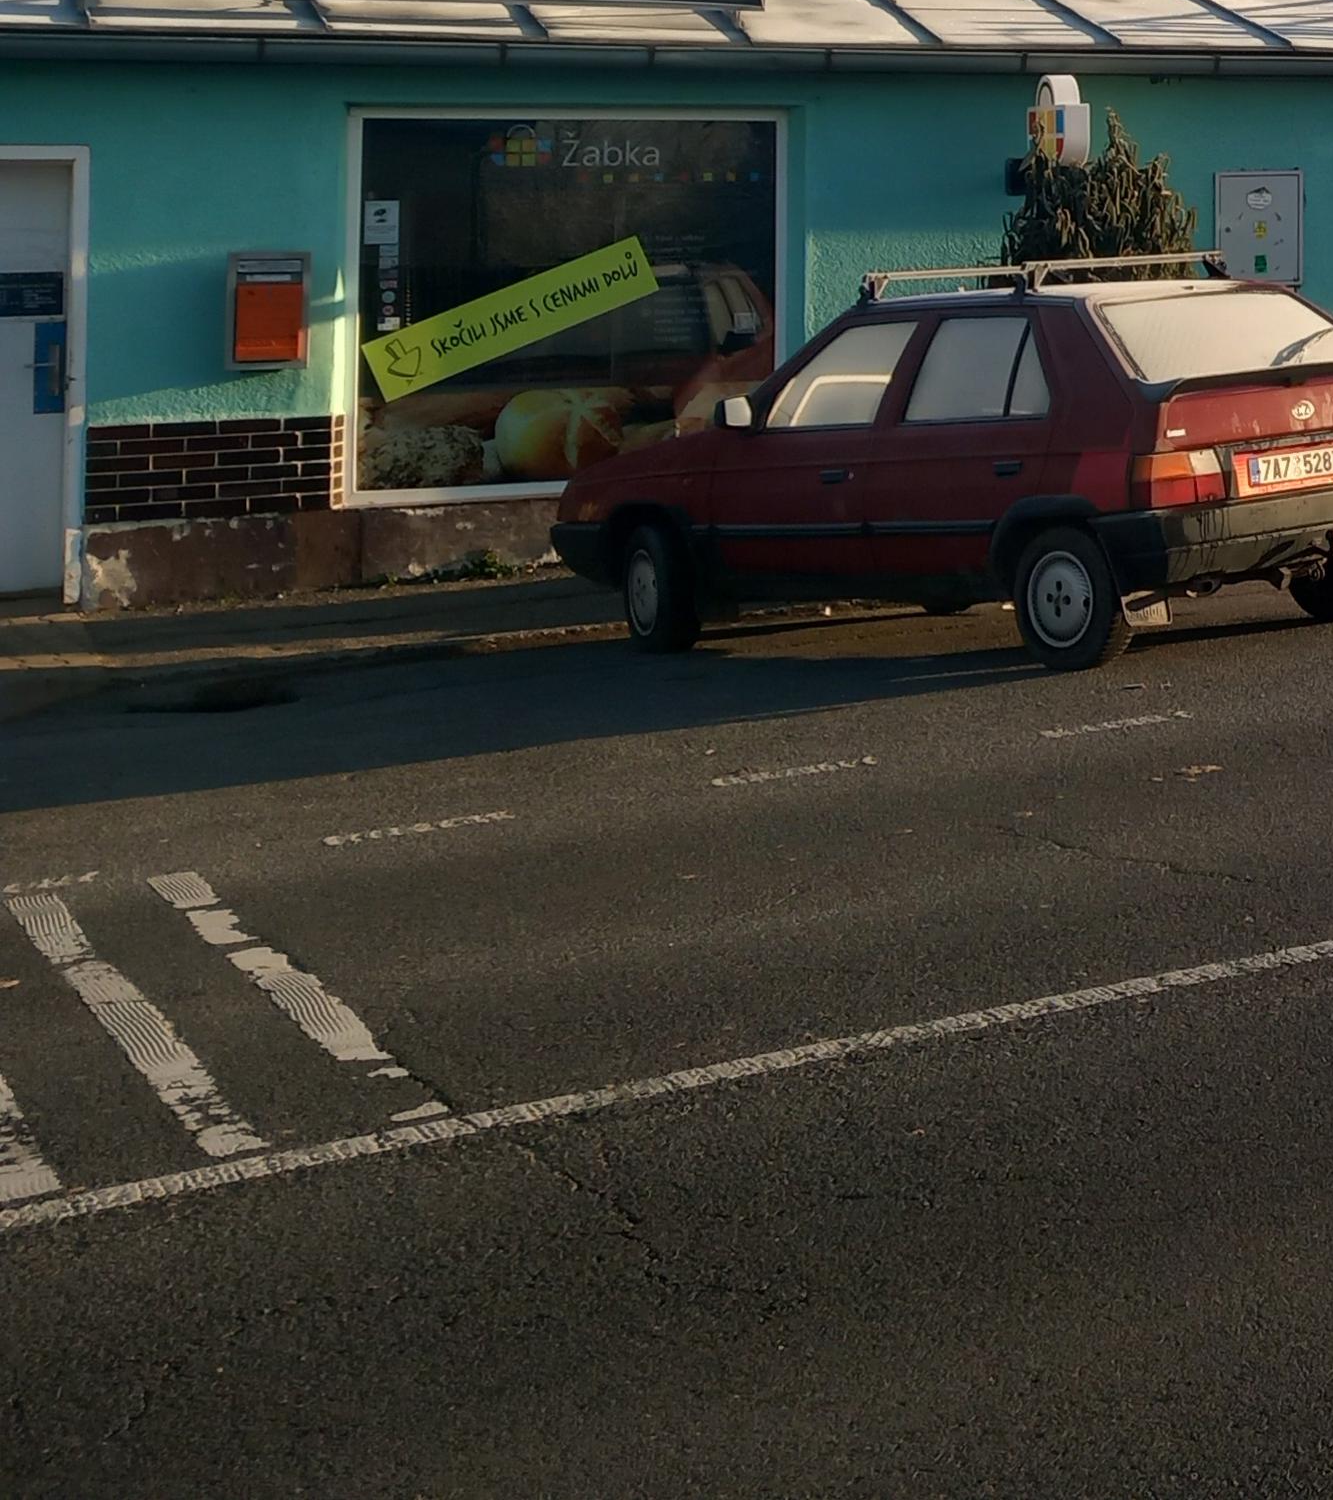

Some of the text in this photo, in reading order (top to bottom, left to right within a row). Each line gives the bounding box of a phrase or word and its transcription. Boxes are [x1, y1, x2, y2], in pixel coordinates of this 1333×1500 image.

[561, 130, 661, 167] Žabka
[429, 251, 639, 359] SKOČILI JSME S CENAMI DOLŮ
[1261, 456, 1291, 482] 7A7
